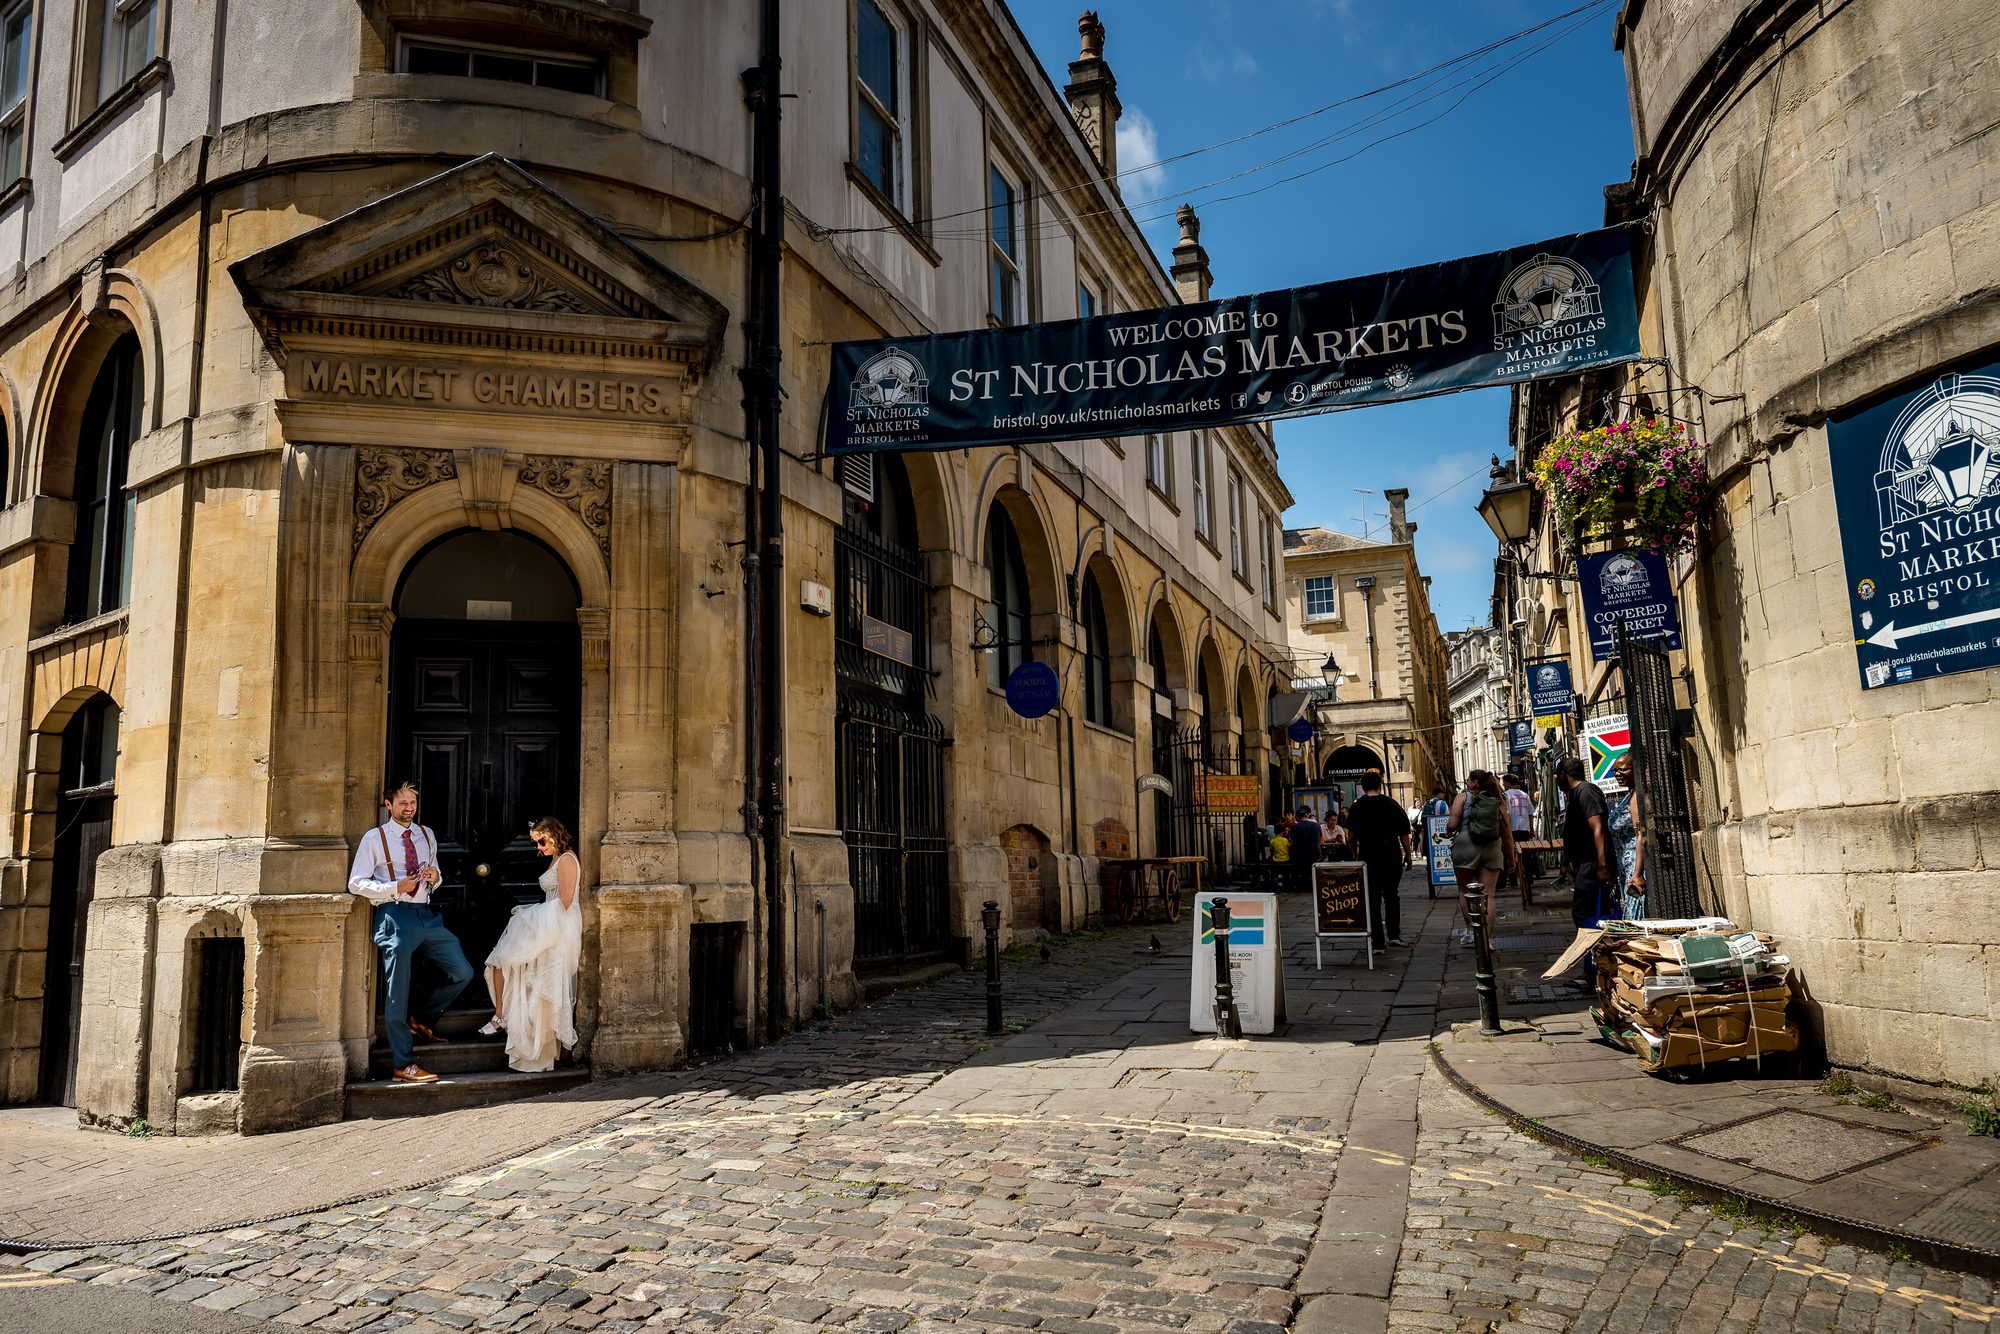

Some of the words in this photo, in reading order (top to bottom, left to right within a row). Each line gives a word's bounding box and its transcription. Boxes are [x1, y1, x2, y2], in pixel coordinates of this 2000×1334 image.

[1108, 311, 1246, 347] WELCOME
[1252, 309, 1278, 329] to
[1494, 335, 1514, 351] ST
[1520, 317, 1606, 346] NICHOLAS
[950, 368, 1000, 402] ST
[1010, 345, 1226, 397] NICHOLAS
[1236, 309, 1467, 375] MARKETS
[1505, 334, 1596, 363] MARKETS
[1496, 357, 1560, 376] BRISTOL
[302, 358, 461, 400] MARKET
[474, 372, 671, 415] CHAMBERS.
[1312, 380, 1343, 392] BRISTOL
[1344, 376, 1373, 388] POUND
[846, 408, 862, 421] ST
[866, 406, 930, 420] NICHOLAS
[993, 397, 1221, 429] bristol.gov.uk/stnicholasmarkets
[854, 420, 920, 434] MARKETS
[847, 434, 894, 444] BRISTOL
[1880, 530, 1910, 560] ST
[1918, 505, 2000, 548] NICH
[1608, 588, 1646, 600] MARKETS
[1614, 582, 1650, 592] NICHOLAS
[1888, 571, 1990, 609] BRISTOL
[1604, 598, 1632, 606] BRISTOL
[1594, 604, 1668, 623] COVERED
[1600, 616, 1664, 636] MRKET
[1534, 689, 1570, 700] COVERED
[1536, 696, 1568, 704] MARKET
[1587, 718, 1612, 730] KALAHARI
[1322, 881, 1360, 898] Sweet
[1326, 896, 1359, 912] Shop
